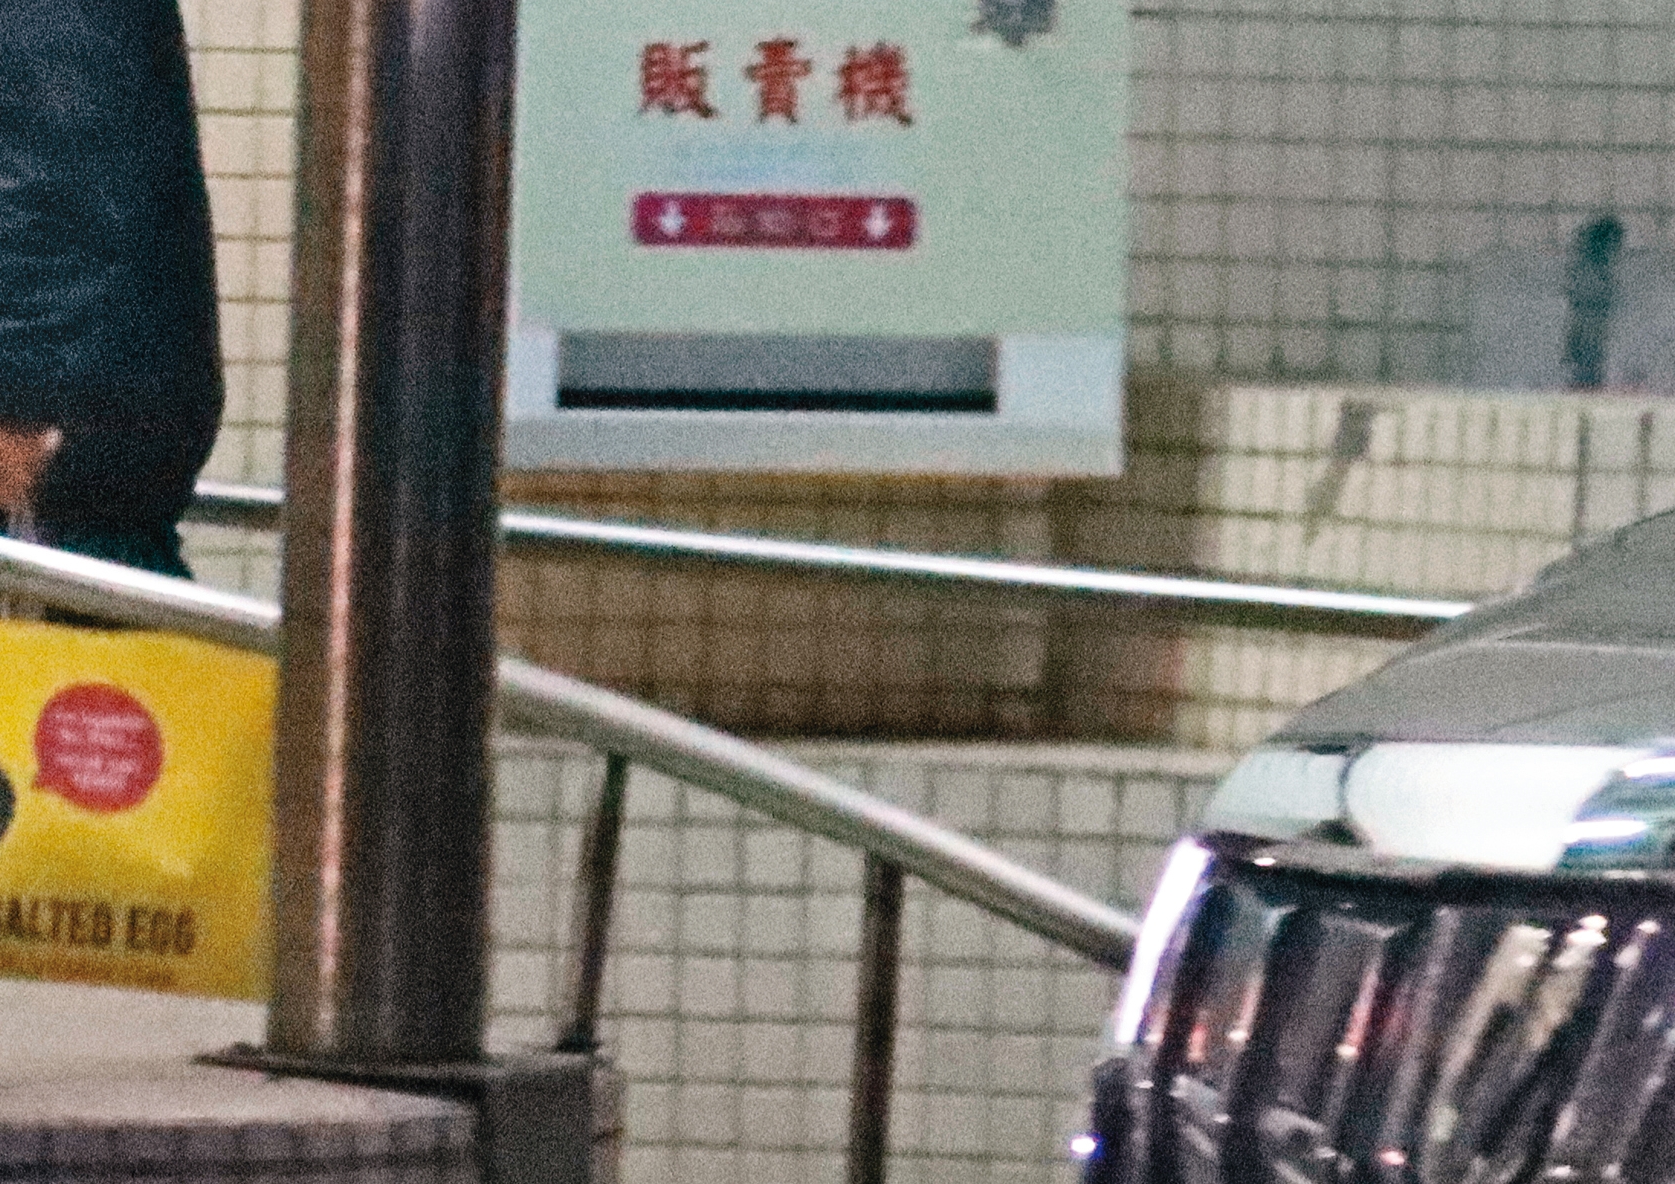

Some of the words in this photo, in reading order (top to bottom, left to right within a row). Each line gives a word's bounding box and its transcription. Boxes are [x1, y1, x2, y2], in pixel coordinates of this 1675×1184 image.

[637, 38, 914, 127] 販賣機
[127, 903, 196, 955] EGG
